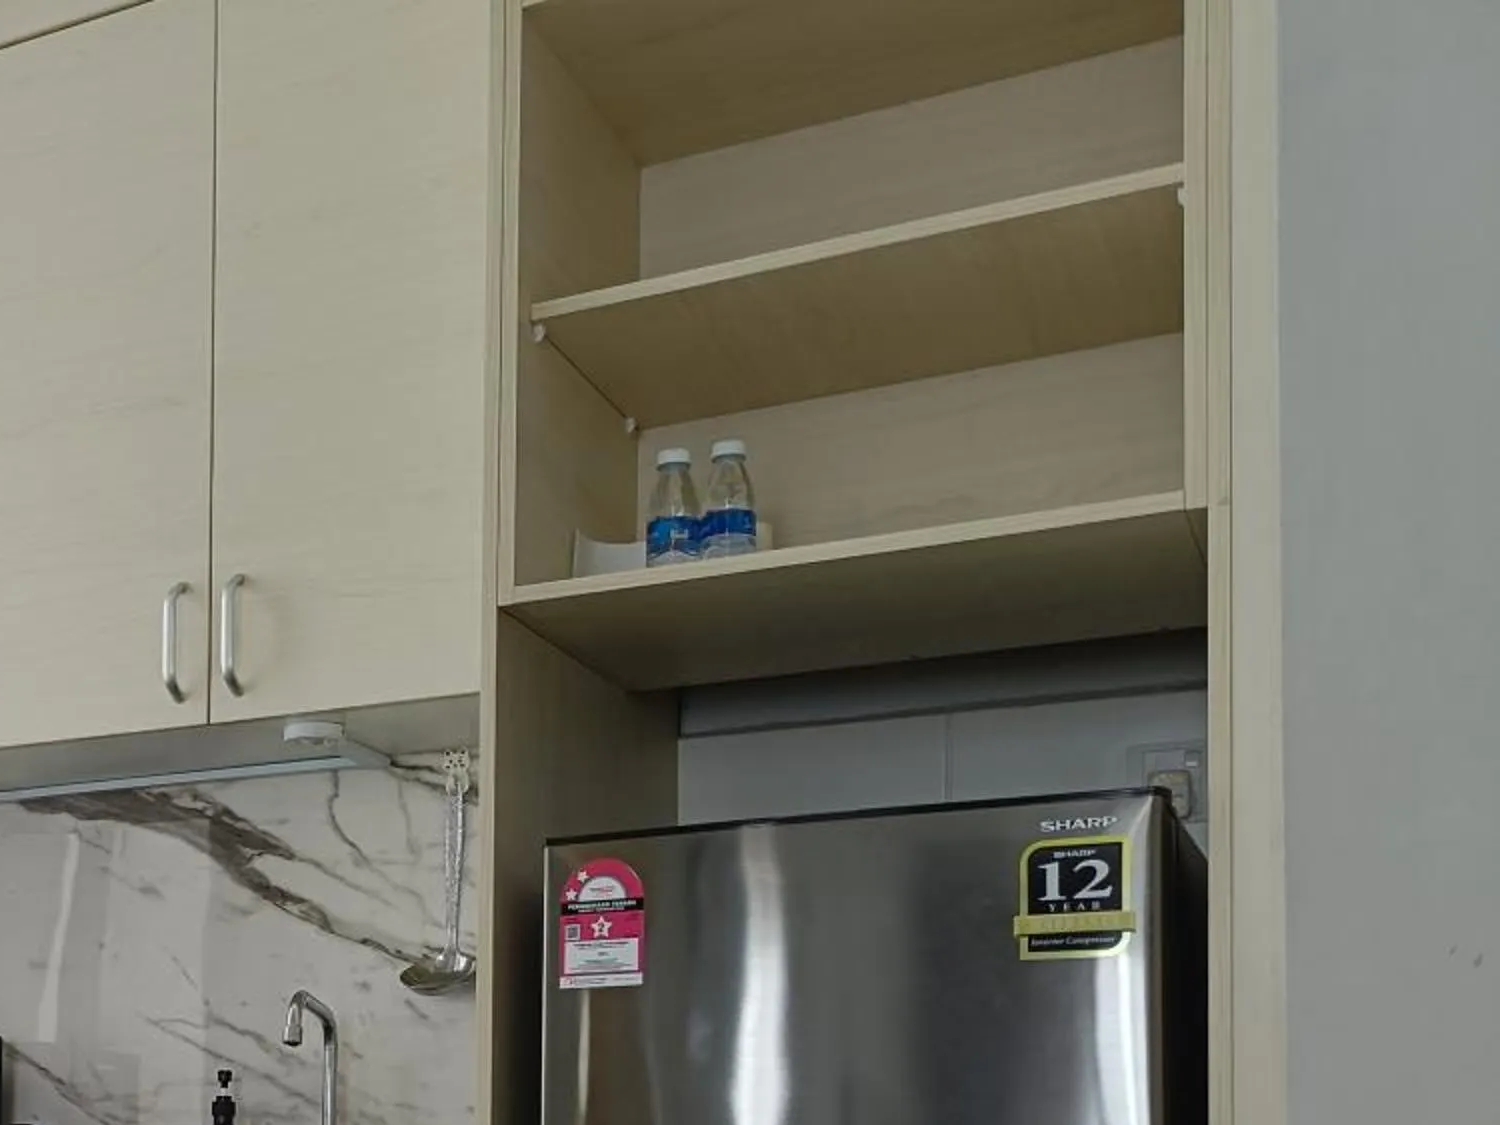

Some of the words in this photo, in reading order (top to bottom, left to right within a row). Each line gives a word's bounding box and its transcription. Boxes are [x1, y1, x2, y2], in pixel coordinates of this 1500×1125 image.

[1040, 816, 1118, 833] SHARP
[1037, 859, 1113, 902] 12
[1048, 901, 1101, 912] YEAR
